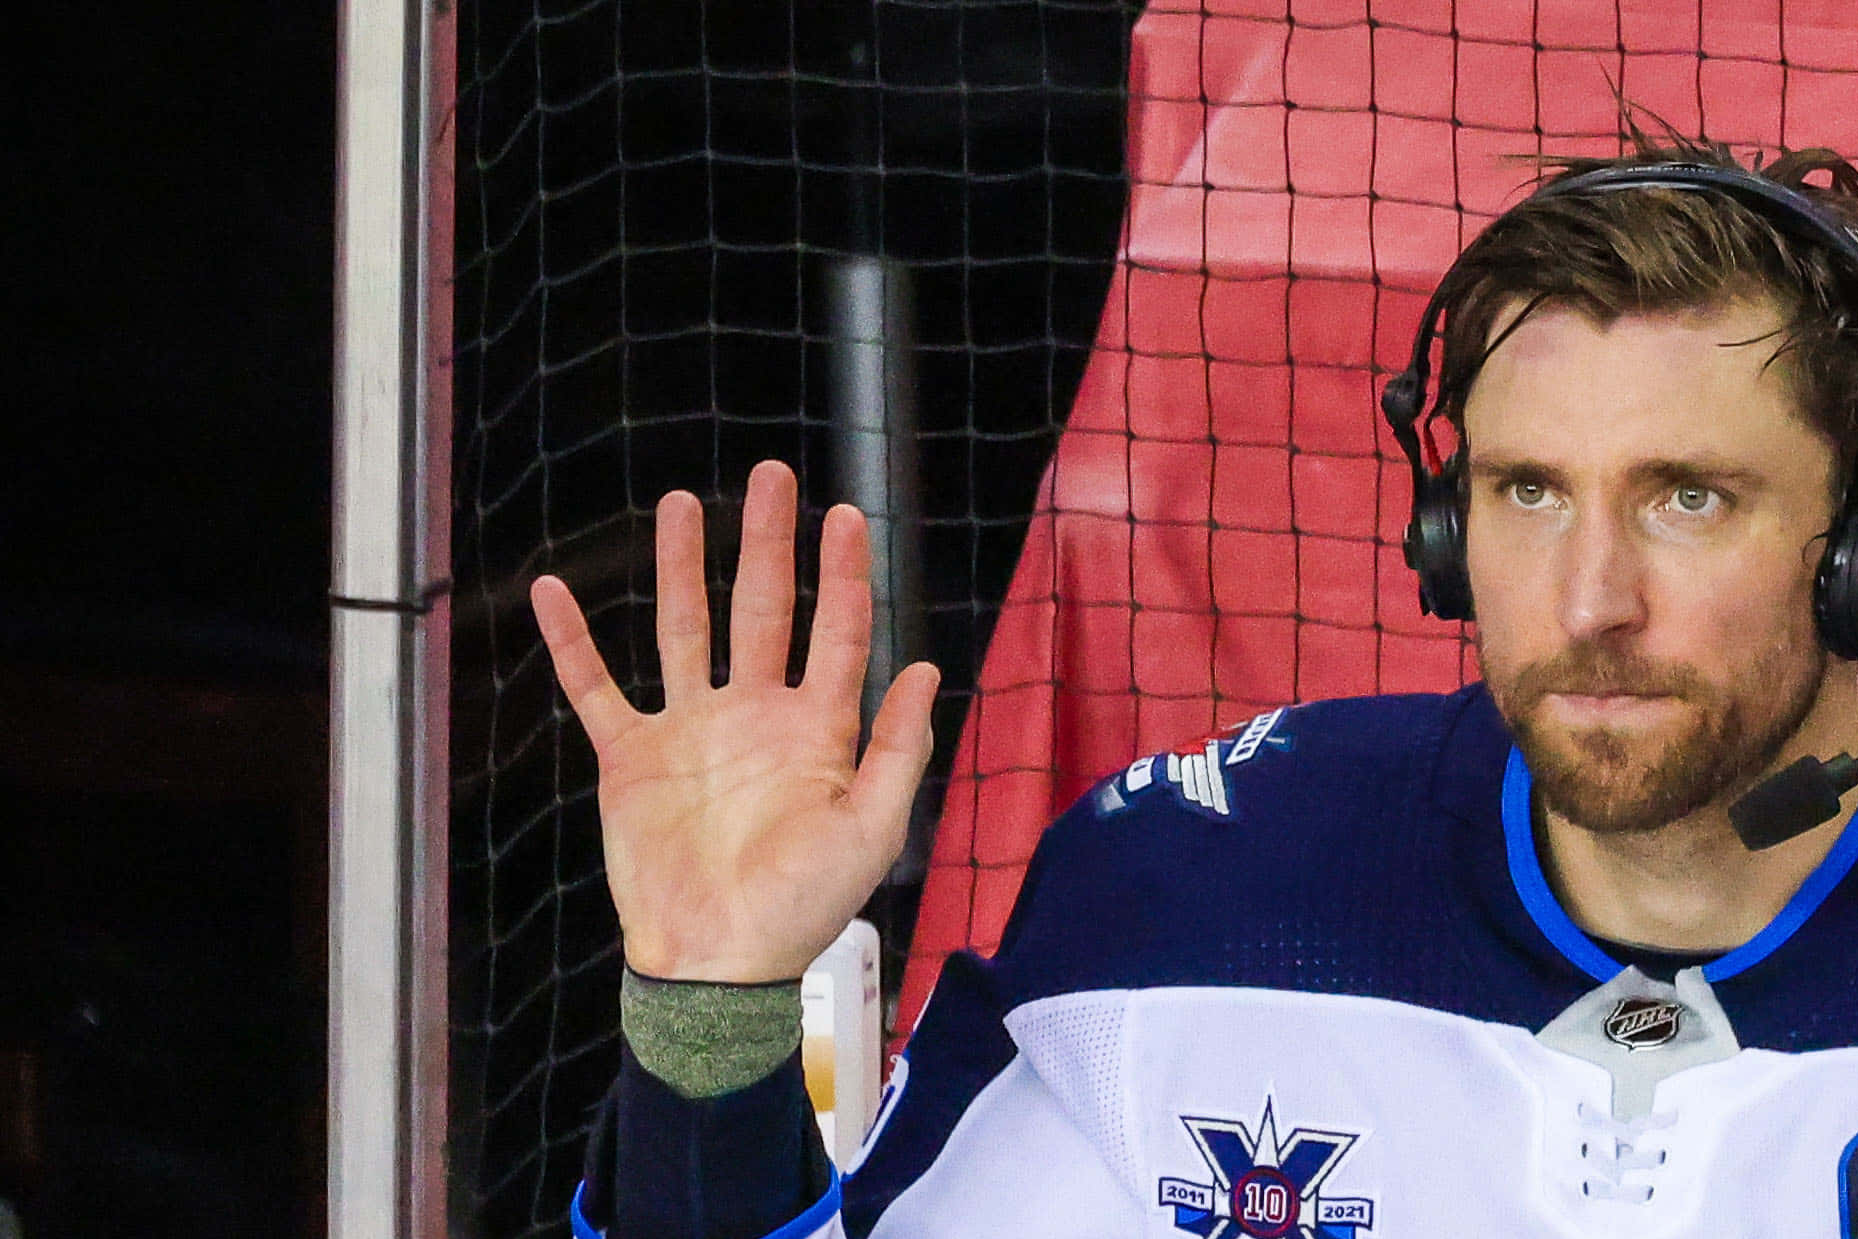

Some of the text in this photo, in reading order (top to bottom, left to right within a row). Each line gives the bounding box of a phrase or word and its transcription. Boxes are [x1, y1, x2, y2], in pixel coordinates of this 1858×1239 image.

[1616, 1006, 1673, 1035] NHL
[1166, 1185, 1206, 1205] 2011
[1244, 1183, 1287, 1224] 10
[1323, 1205, 1365, 1219] 2021
